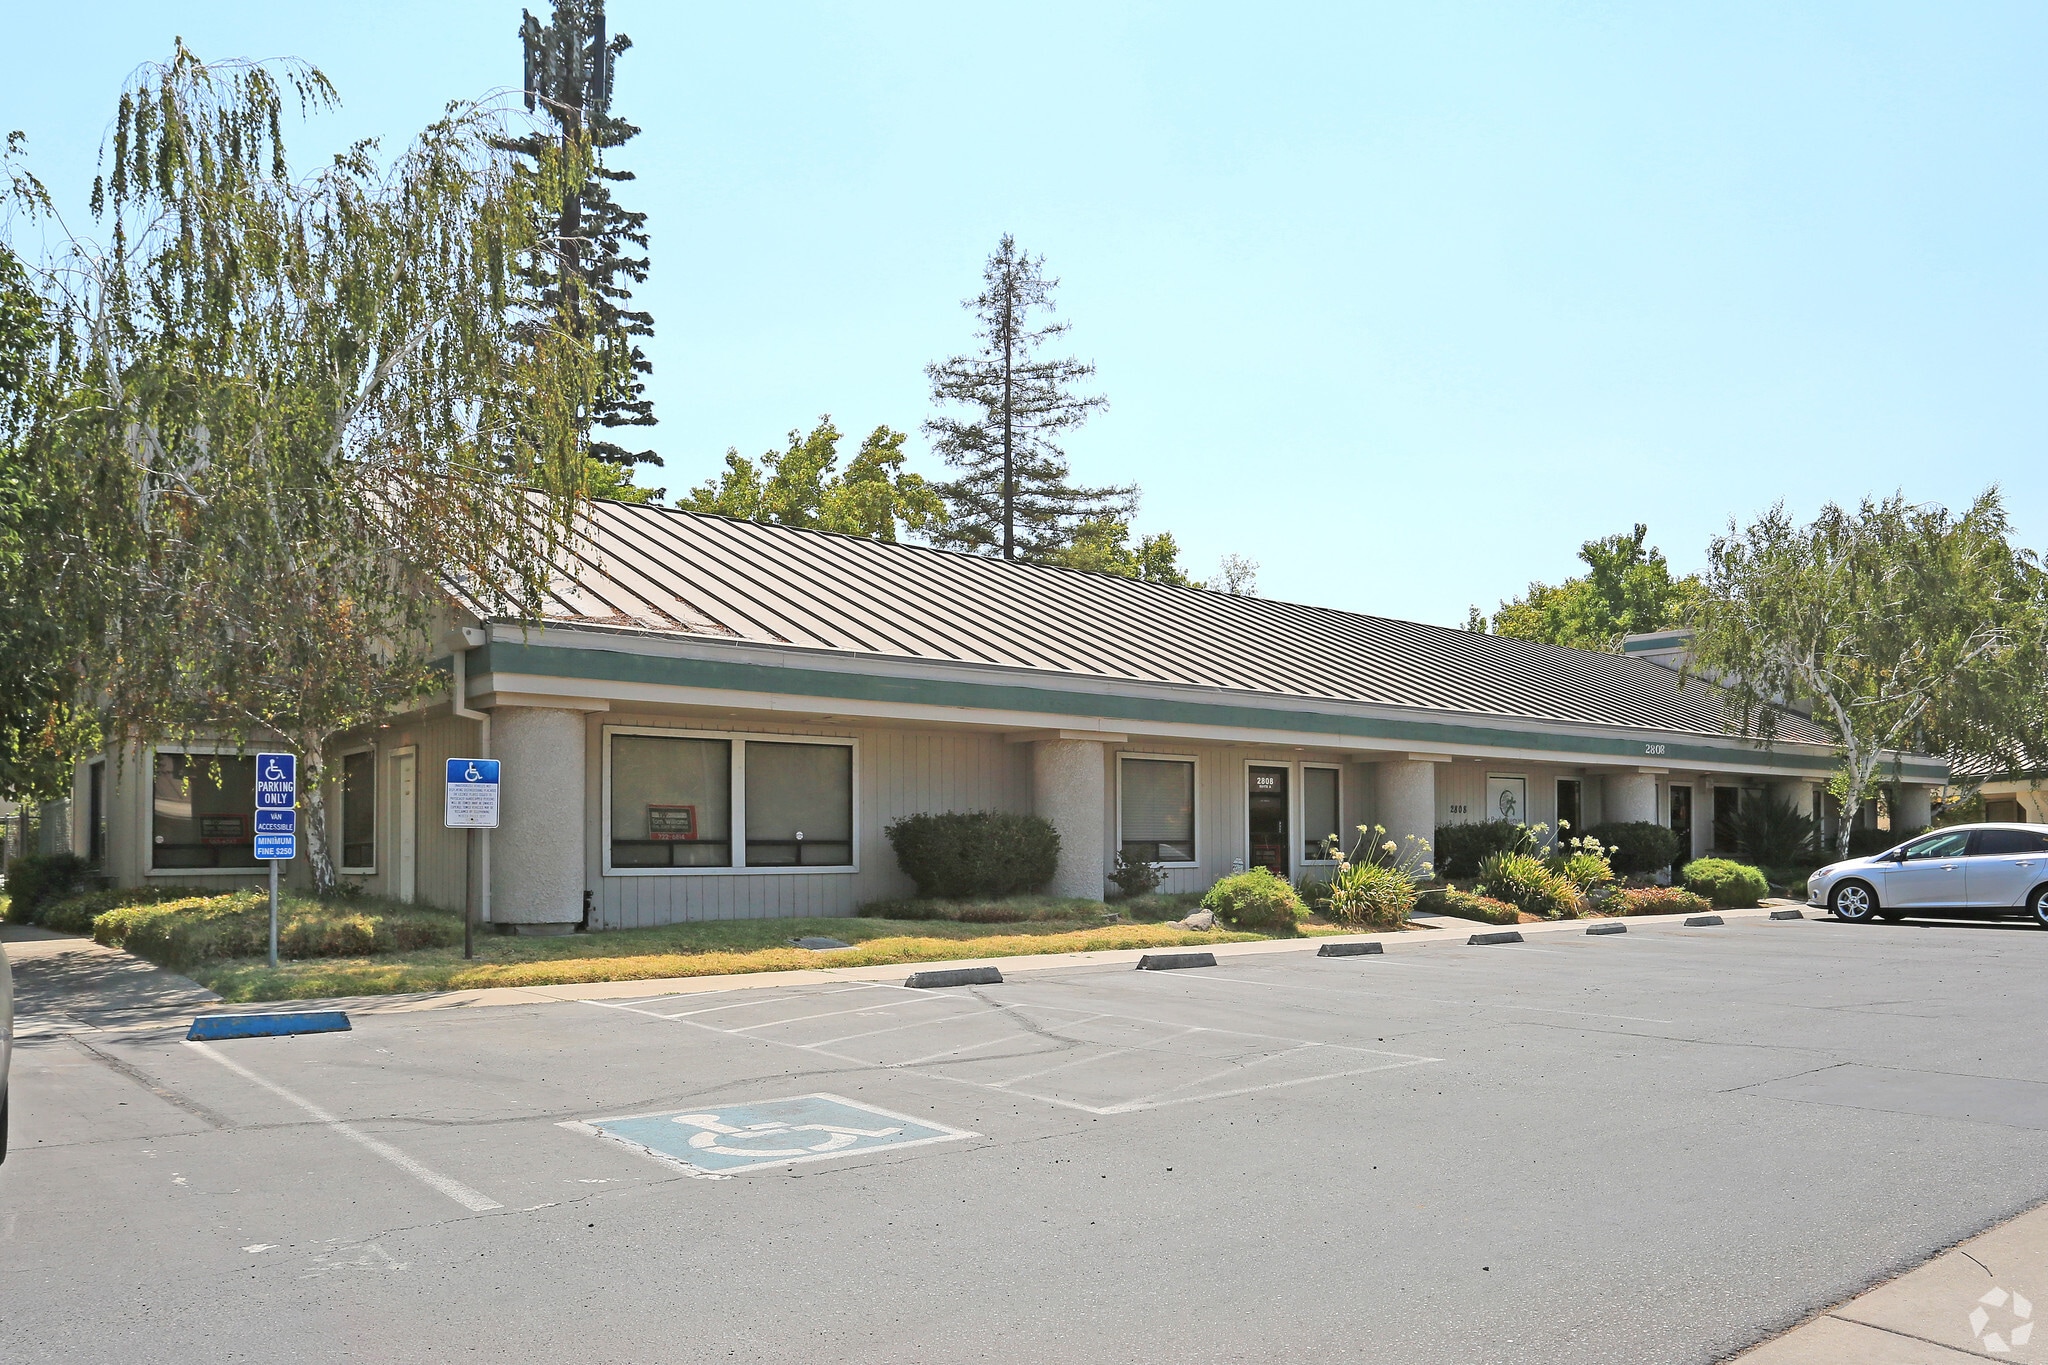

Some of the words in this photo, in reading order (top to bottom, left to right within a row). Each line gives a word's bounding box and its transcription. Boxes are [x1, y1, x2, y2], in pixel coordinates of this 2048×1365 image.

[1645, 744, 1665, 755] 2808
[1256, 777, 1274, 785] 2808
[258, 781, 294, 792] PARKING
[264, 793, 287, 804] ONLY
[1450, 805, 1467, 814] 2808
[258, 823, 293, 831] ACCESSIBLE
[257, 837, 292, 845] MINIMUM
[257, 847, 274, 855] FINE
[275, 847, 292, 855] $250
